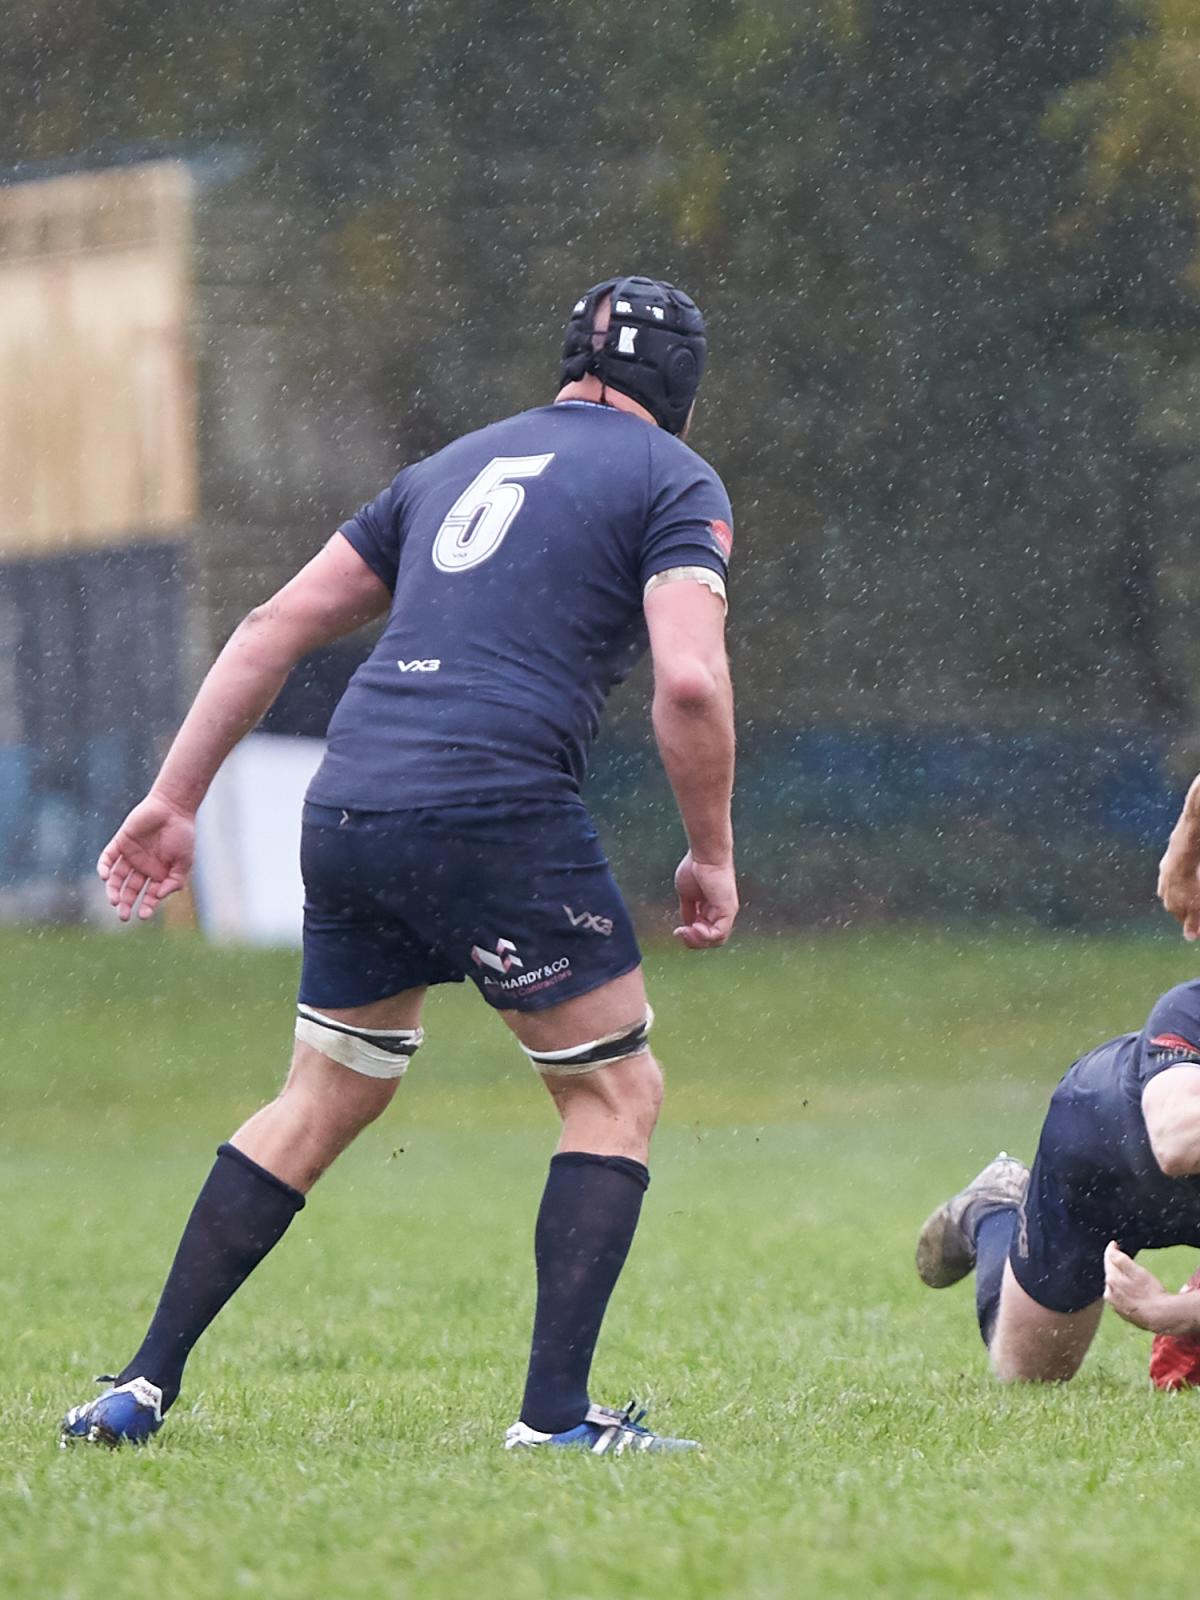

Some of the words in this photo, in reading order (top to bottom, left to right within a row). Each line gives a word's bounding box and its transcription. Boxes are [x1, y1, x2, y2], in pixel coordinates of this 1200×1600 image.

[432, 453, 556, 573] 5
[398, 659, 441, 672] VX3
[562, 904, 614, 936] VX3
